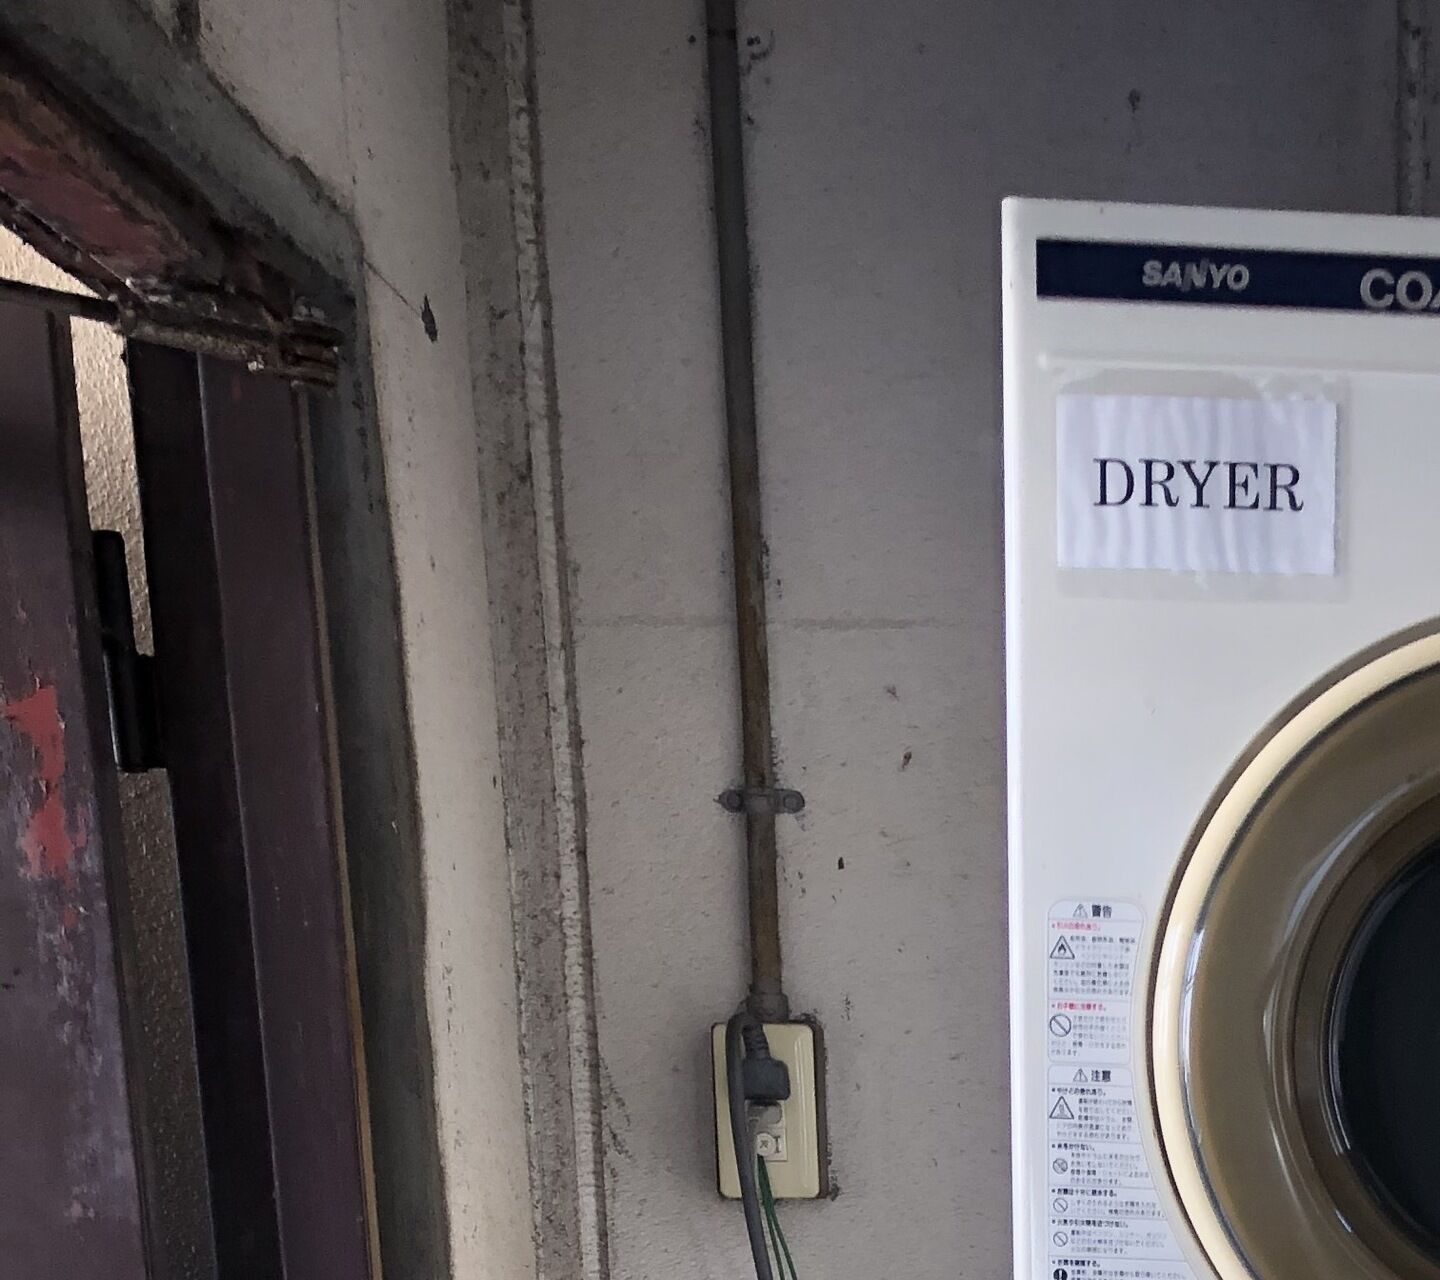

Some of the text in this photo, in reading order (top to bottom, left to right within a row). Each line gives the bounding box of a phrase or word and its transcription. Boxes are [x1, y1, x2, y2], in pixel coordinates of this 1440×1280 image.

[1142, 259, 1250, 291] SANYO
[1092, 456, 1304, 514] DRYER
[1091, 904, 1112, 918] 警告
[1091, 1069, 1111, 1082] 注意
